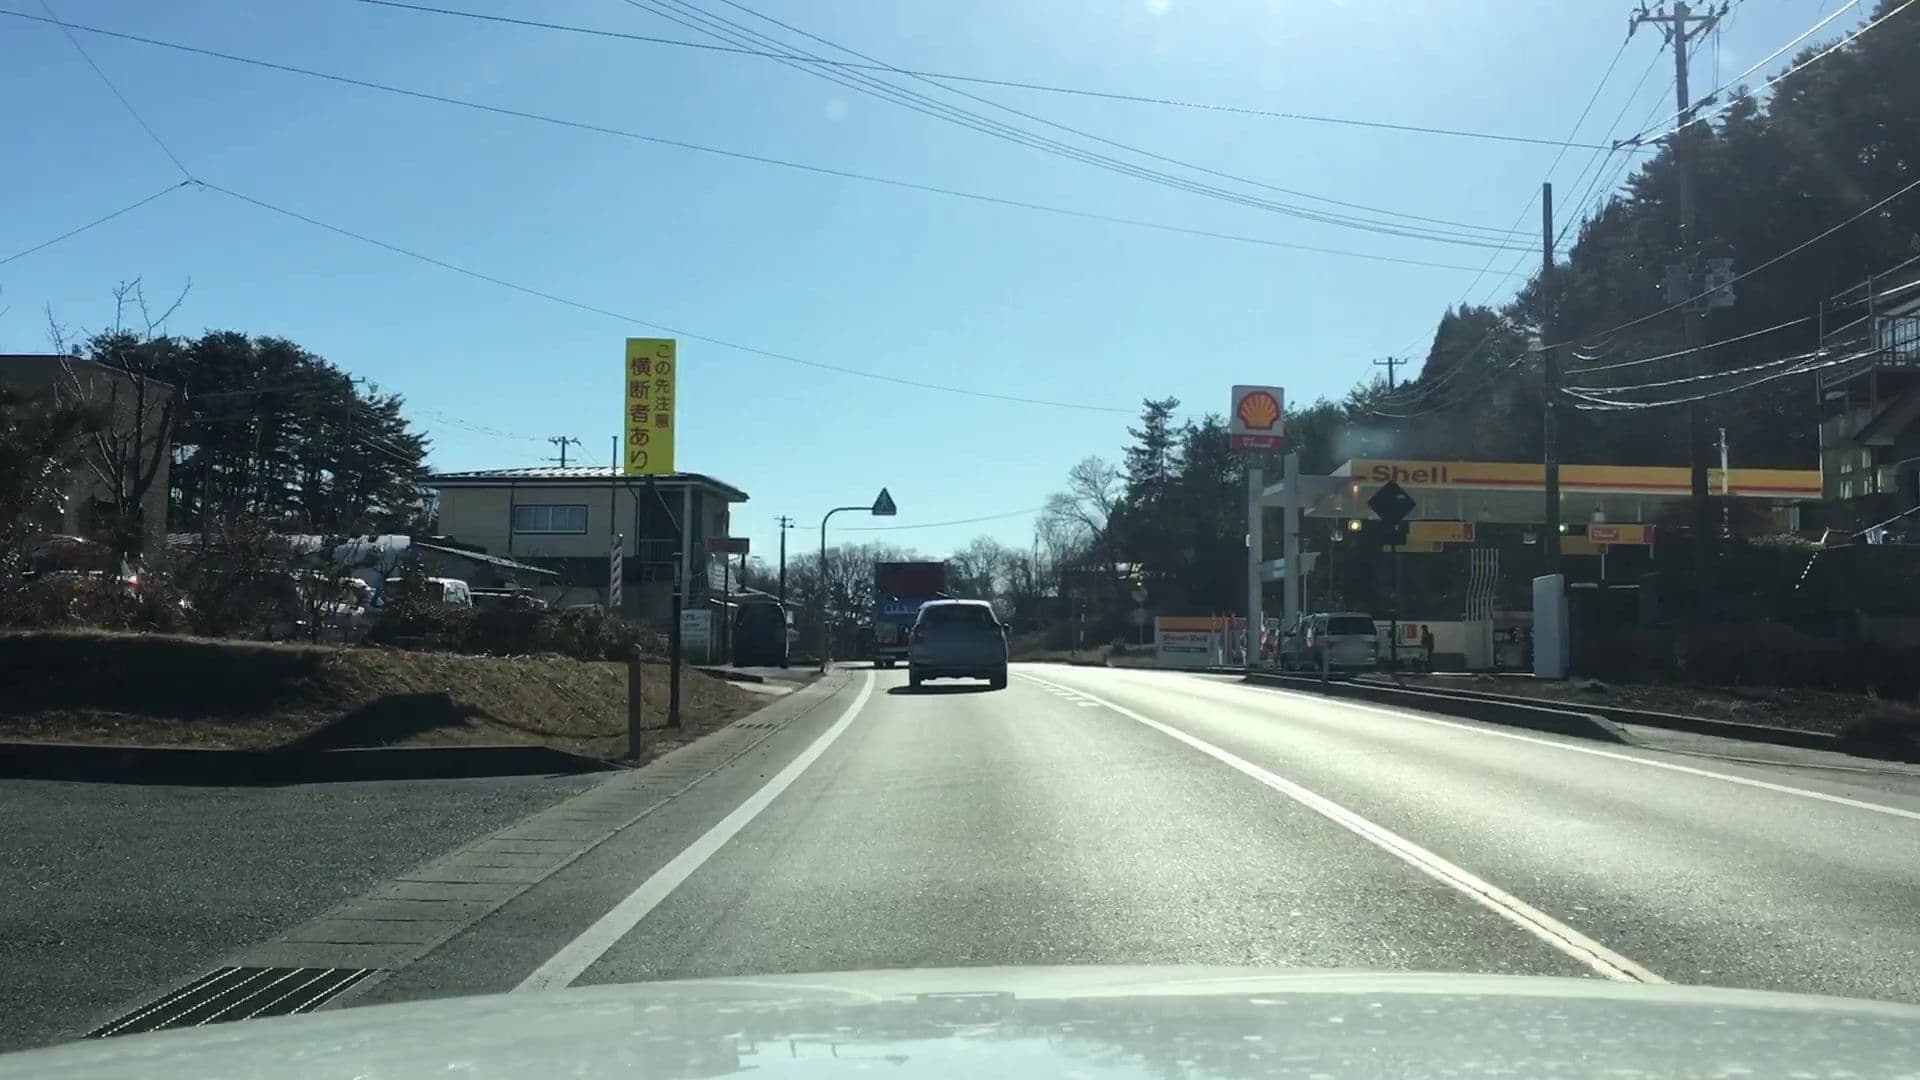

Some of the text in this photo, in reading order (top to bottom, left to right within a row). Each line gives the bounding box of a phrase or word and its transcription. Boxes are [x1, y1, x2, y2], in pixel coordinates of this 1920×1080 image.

[629, 357, 652, 470] 横断者あり
[1372, 465, 1448, 484] Shell
